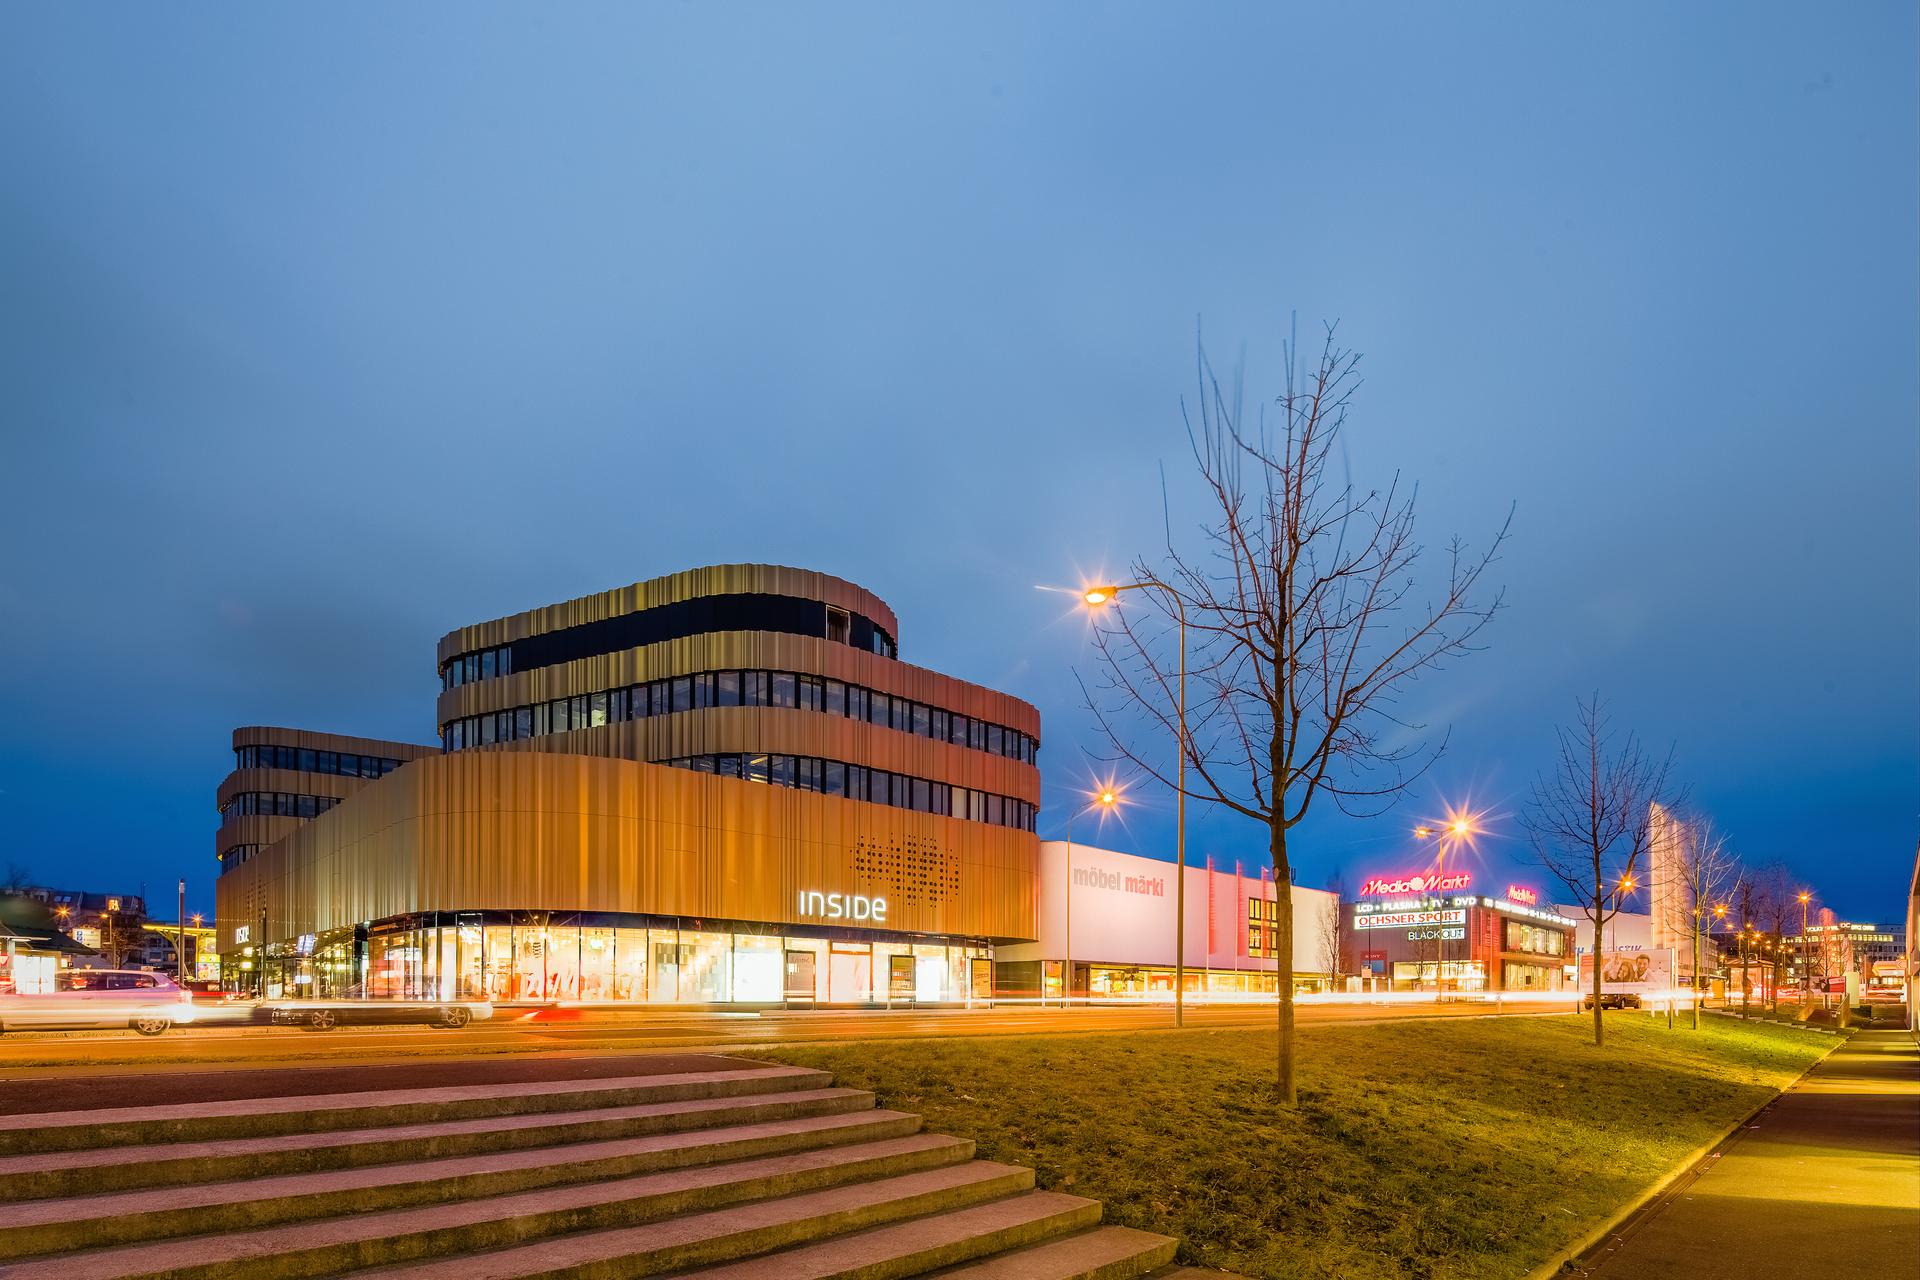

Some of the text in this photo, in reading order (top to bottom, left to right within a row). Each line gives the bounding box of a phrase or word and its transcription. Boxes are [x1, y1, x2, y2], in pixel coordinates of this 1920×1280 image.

[1074, 867, 1164, 897] möbel märki
[1361, 875, 1470, 895] Media Markt
[1357, 904, 1373, 912] LCD
[1431, 899, 1444, 907] TV
[1455, 897, 1476, 906] DVD
[1359, 911, 1461, 926] OCHSNER SPORT
